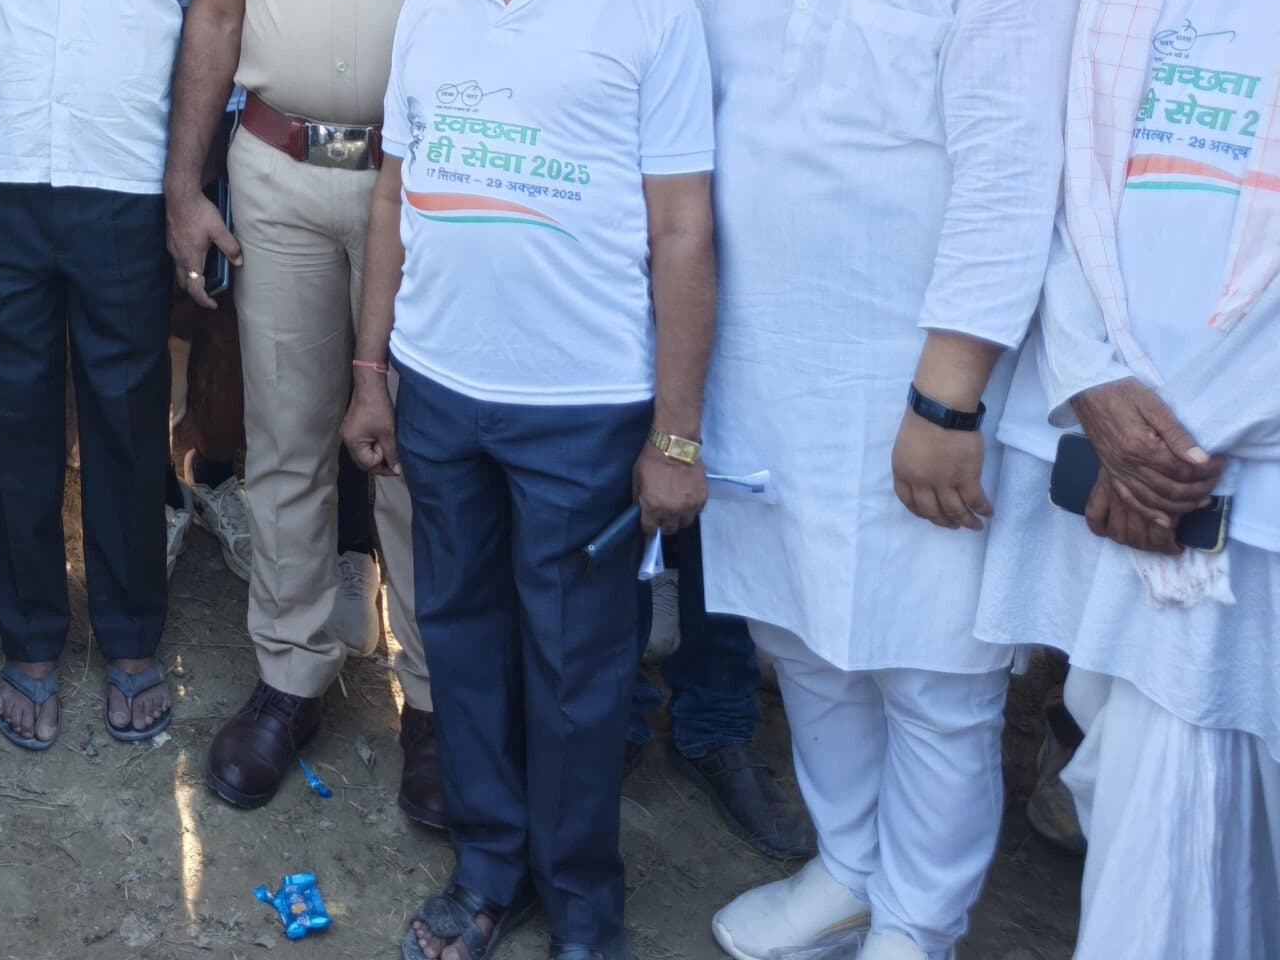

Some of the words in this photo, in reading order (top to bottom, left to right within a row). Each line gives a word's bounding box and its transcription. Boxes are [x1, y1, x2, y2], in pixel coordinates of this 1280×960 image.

[1164, 93, 1237, 131] सेवा
[433, 113, 542, 147] स्वच्छता
[1188, 136, 1206, 149] 29
[426, 136, 456, 164] ही
[461, 142, 527, 175] सेवा
[530, 156, 591, 185] 2025
[426, 168, 437, 178] 17
[486, 178, 502, 189] 29
[551, 189, 582, 201] 2025
